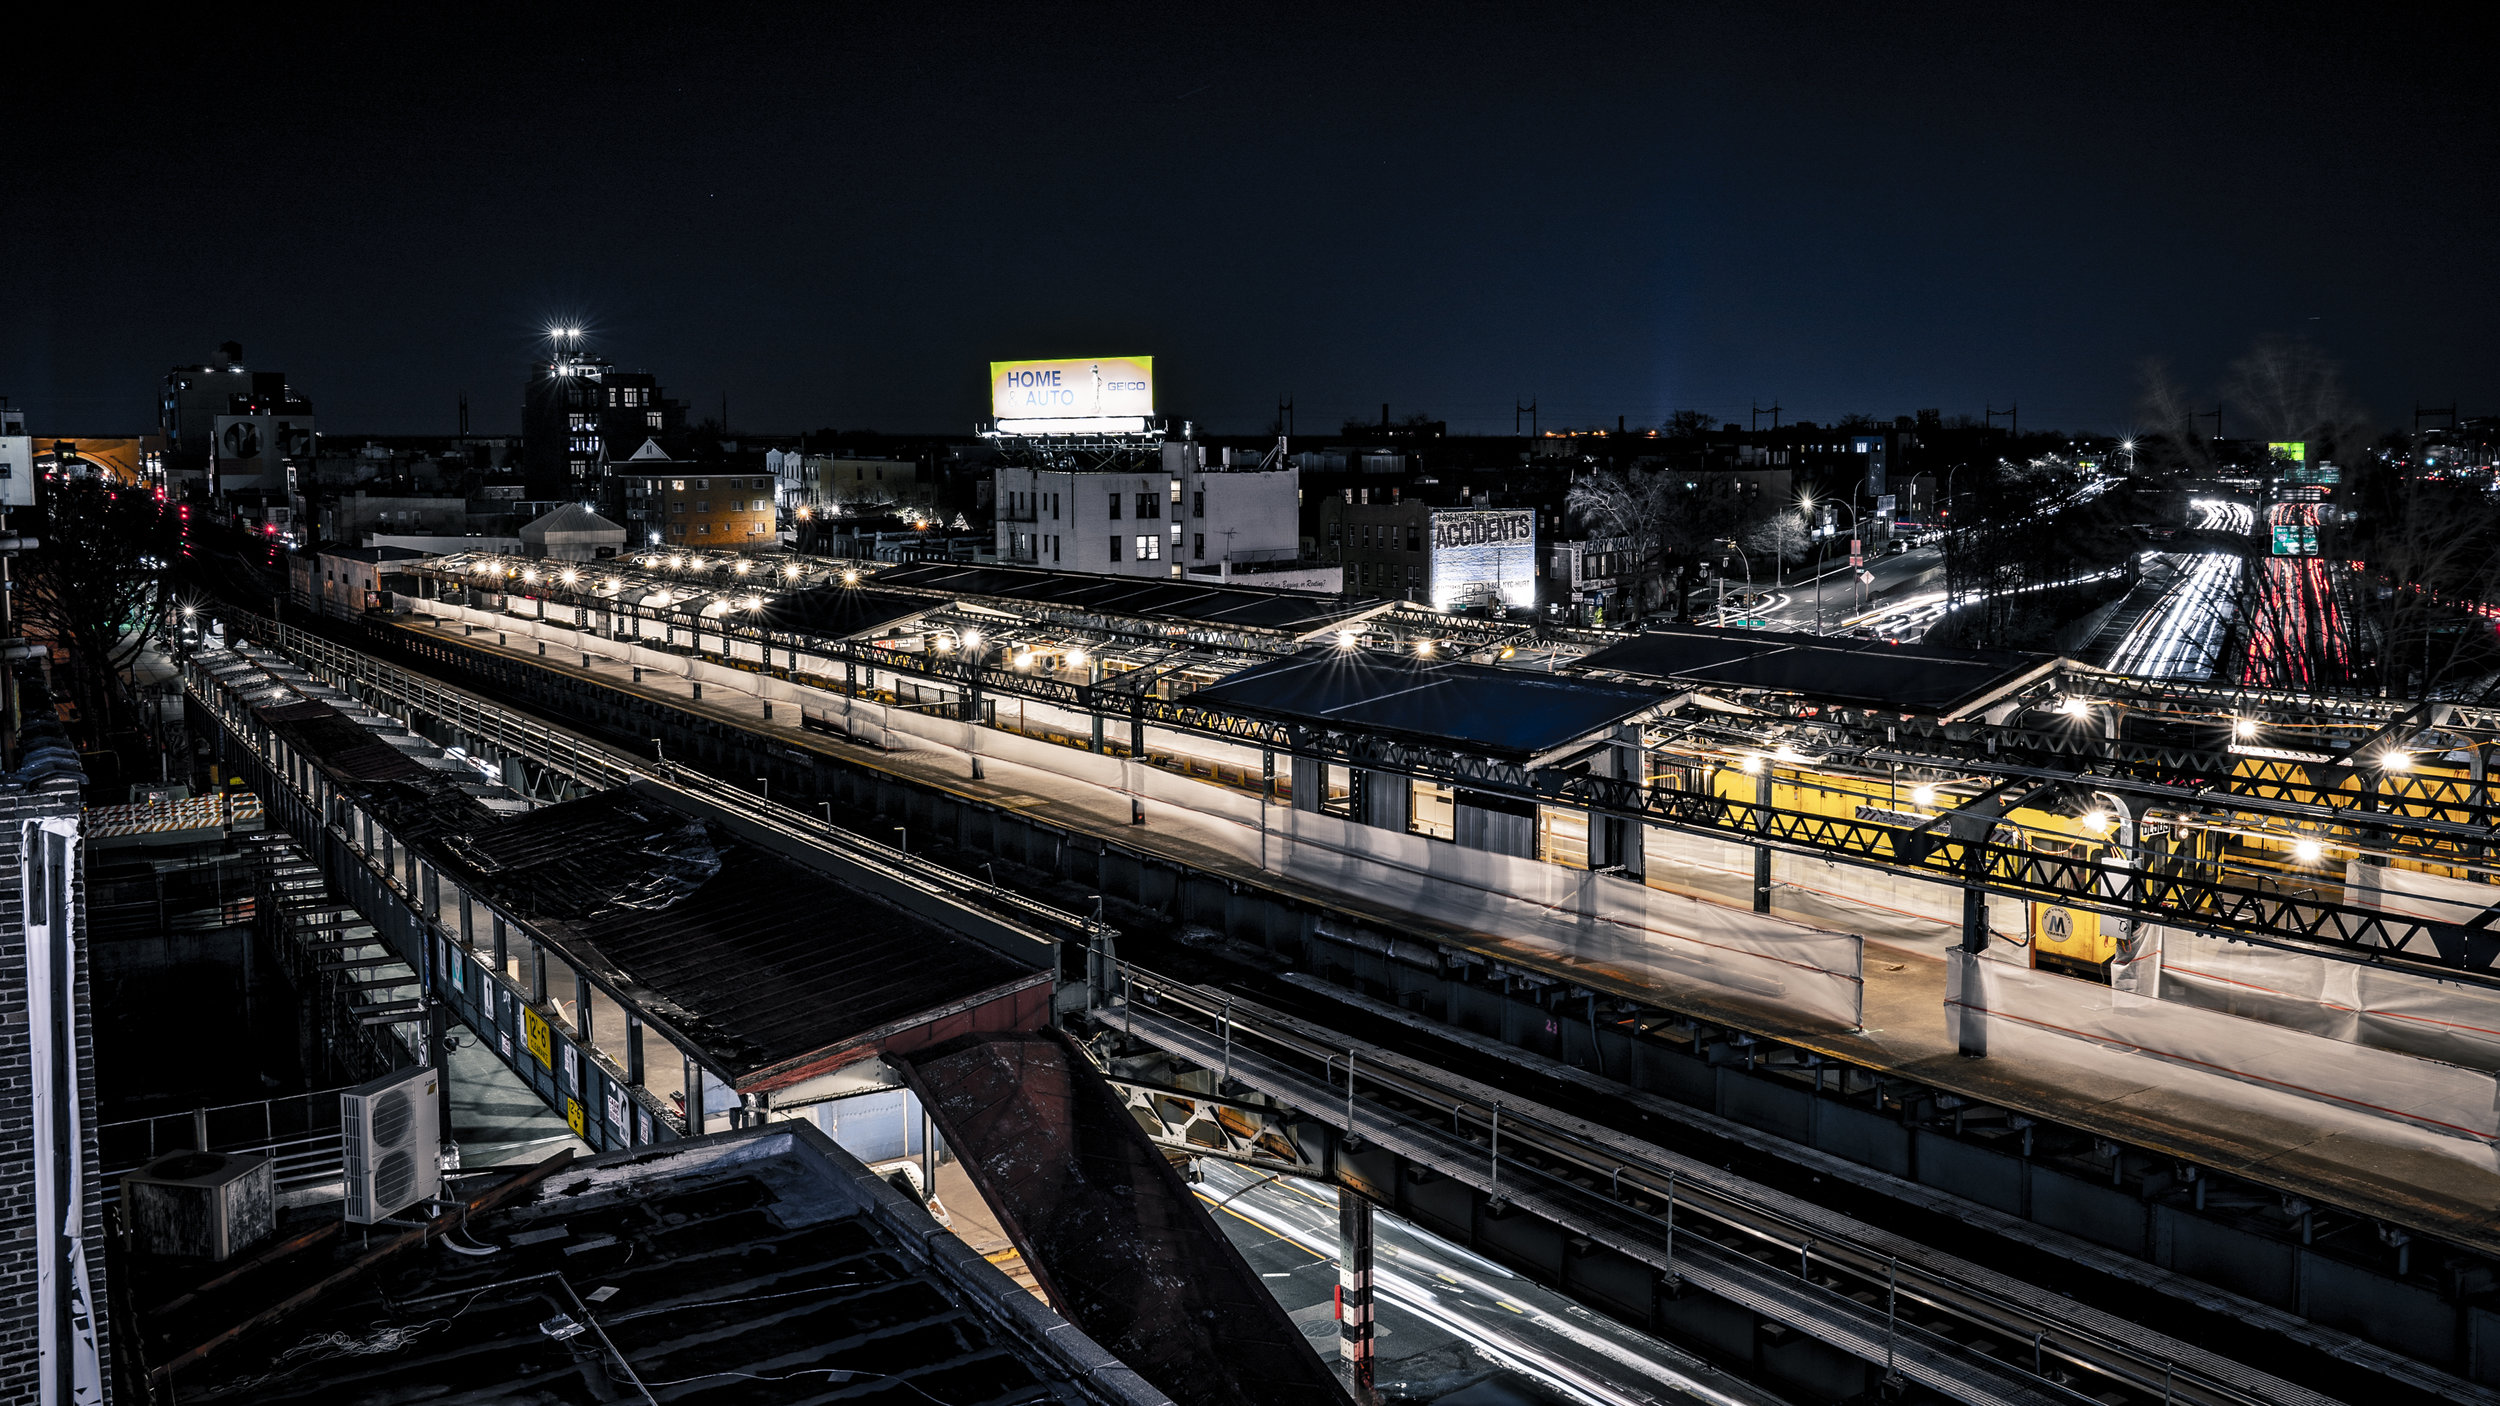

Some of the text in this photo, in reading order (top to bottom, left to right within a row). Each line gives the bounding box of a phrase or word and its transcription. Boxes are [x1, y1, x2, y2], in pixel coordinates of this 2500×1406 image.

[1008, 371, 1061, 387] HOME
[1108, 381, 1145, 391] GEICO
[1008, 390, 1073, 407] & AUTO
[1435, 514, 1530, 550] ACCIDENTS
[1583, 538, 1608, 555] JERRY
[1883, 816, 1908, 825] PLATFORM
